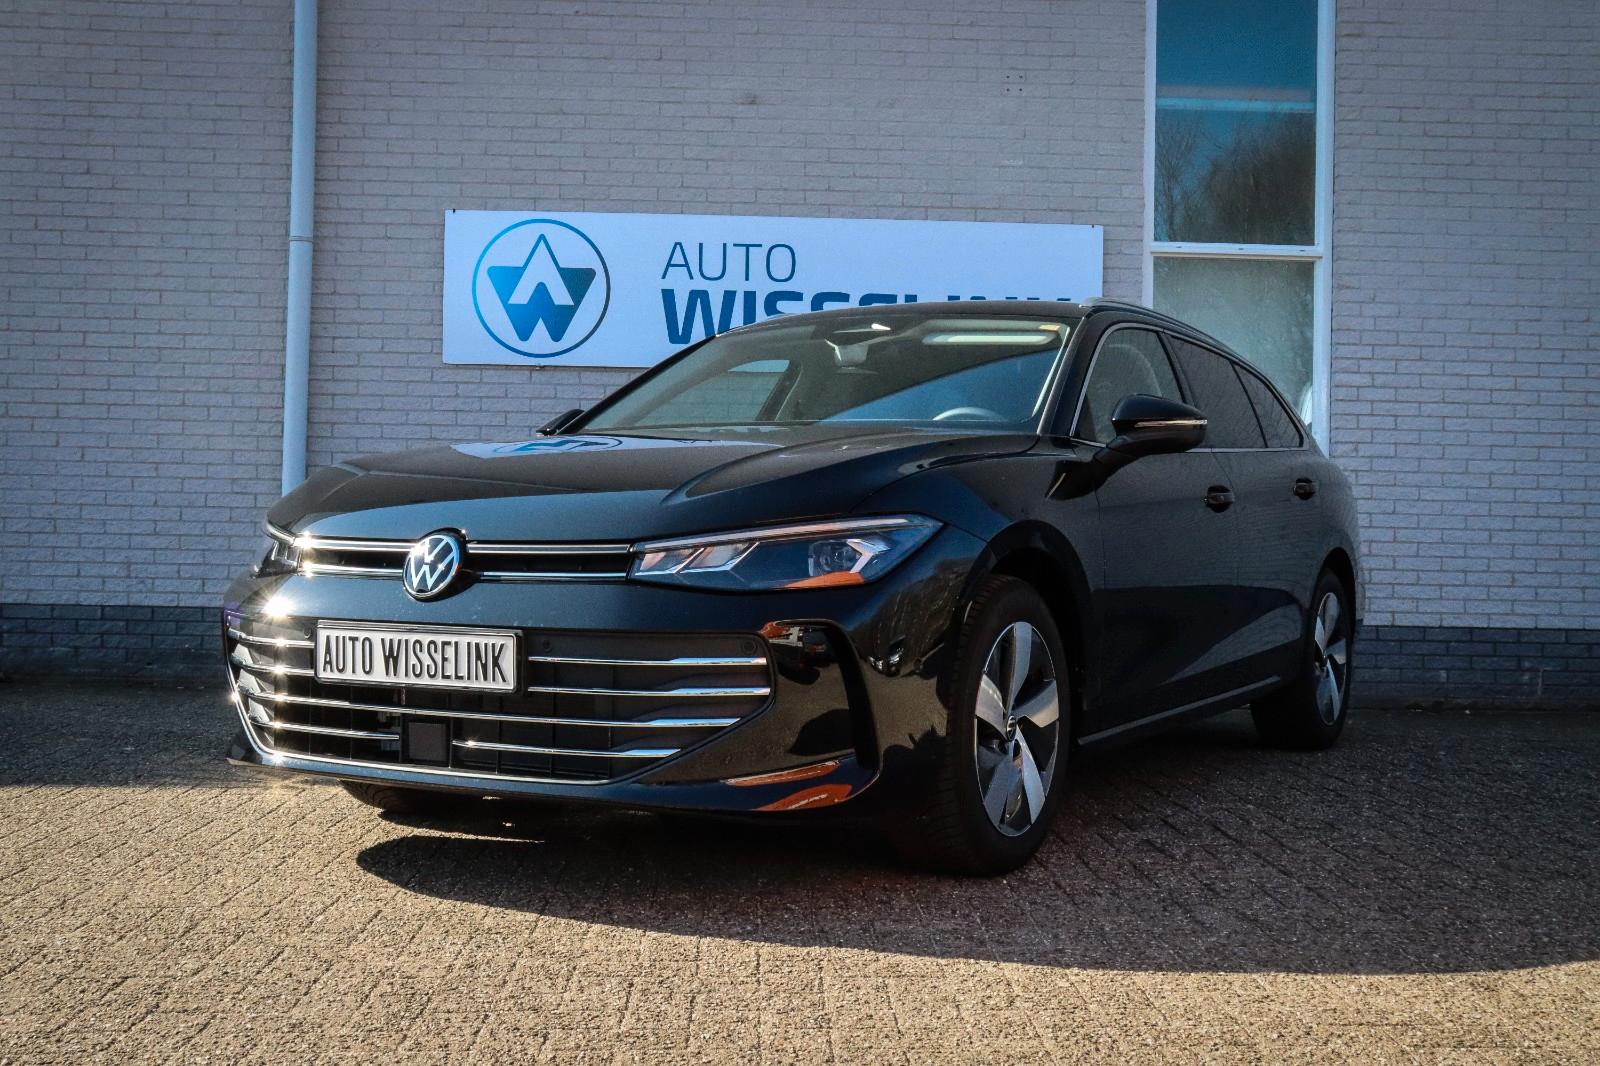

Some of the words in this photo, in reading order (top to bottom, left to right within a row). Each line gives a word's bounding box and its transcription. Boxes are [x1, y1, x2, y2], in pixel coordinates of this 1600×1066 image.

[661, 241, 796, 283] AUTO
[322, 634, 373, 675] AUTO
[380, 637, 506, 683] WISSELINK
